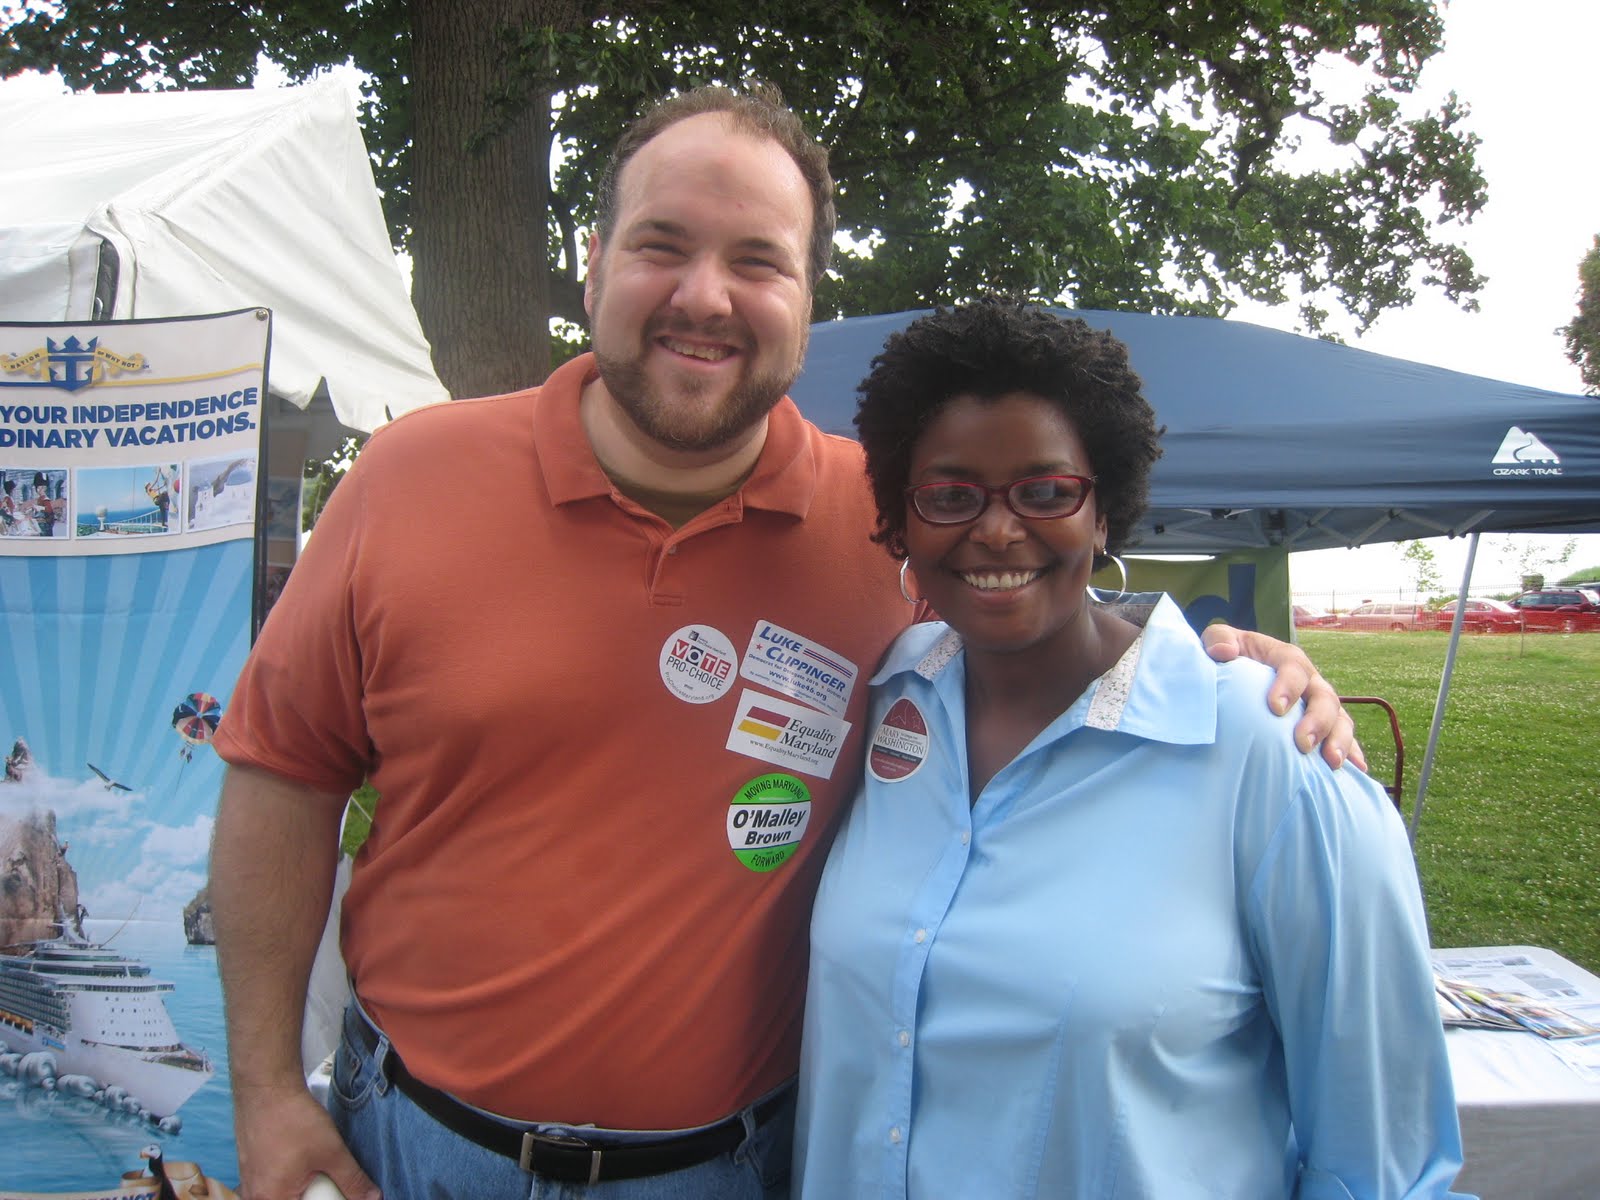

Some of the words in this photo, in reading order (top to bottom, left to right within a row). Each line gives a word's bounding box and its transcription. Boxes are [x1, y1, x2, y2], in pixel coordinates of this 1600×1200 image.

[10, 353, 40, 368] NATION
[105, 353, 120, 363] WHY
[0, 405, 68, 424] YOUR
[73, 387, 258, 424] INDEPENDENCE
[0, 428, 100, 448] DINARY
[104, 411, 256, 447] VACATIONS.
[1493, 468, 1530, 476] OZARK
[759, 626, 803, 653] LUKE
[666, 655, 724, 691] PRO-CHOICE
[671, 639, 731, 680] VOTE
[748, 653, 774, 667] Democrat
[765, 646, 846, 692] CLIPPINGER
[769, 670, 828, 702] www.luke46.org
[780, 732, 838, 759] Maryland
[788, 718, 836, 746] Equality
[877, 734, 924, 755] WASHINGTON
[882, 727, 899, 739] MARY
[749, 739, 819, 766] www.EqualityMaryland.org
[744, 779, 772, 801] MOVING
[772, 779, 804, 799] MARYLAND
[733, 808, 807, 829] O'Malley
[745, 830, 792, 846] Brown
[751, 850, 785, 868] FORWARD
